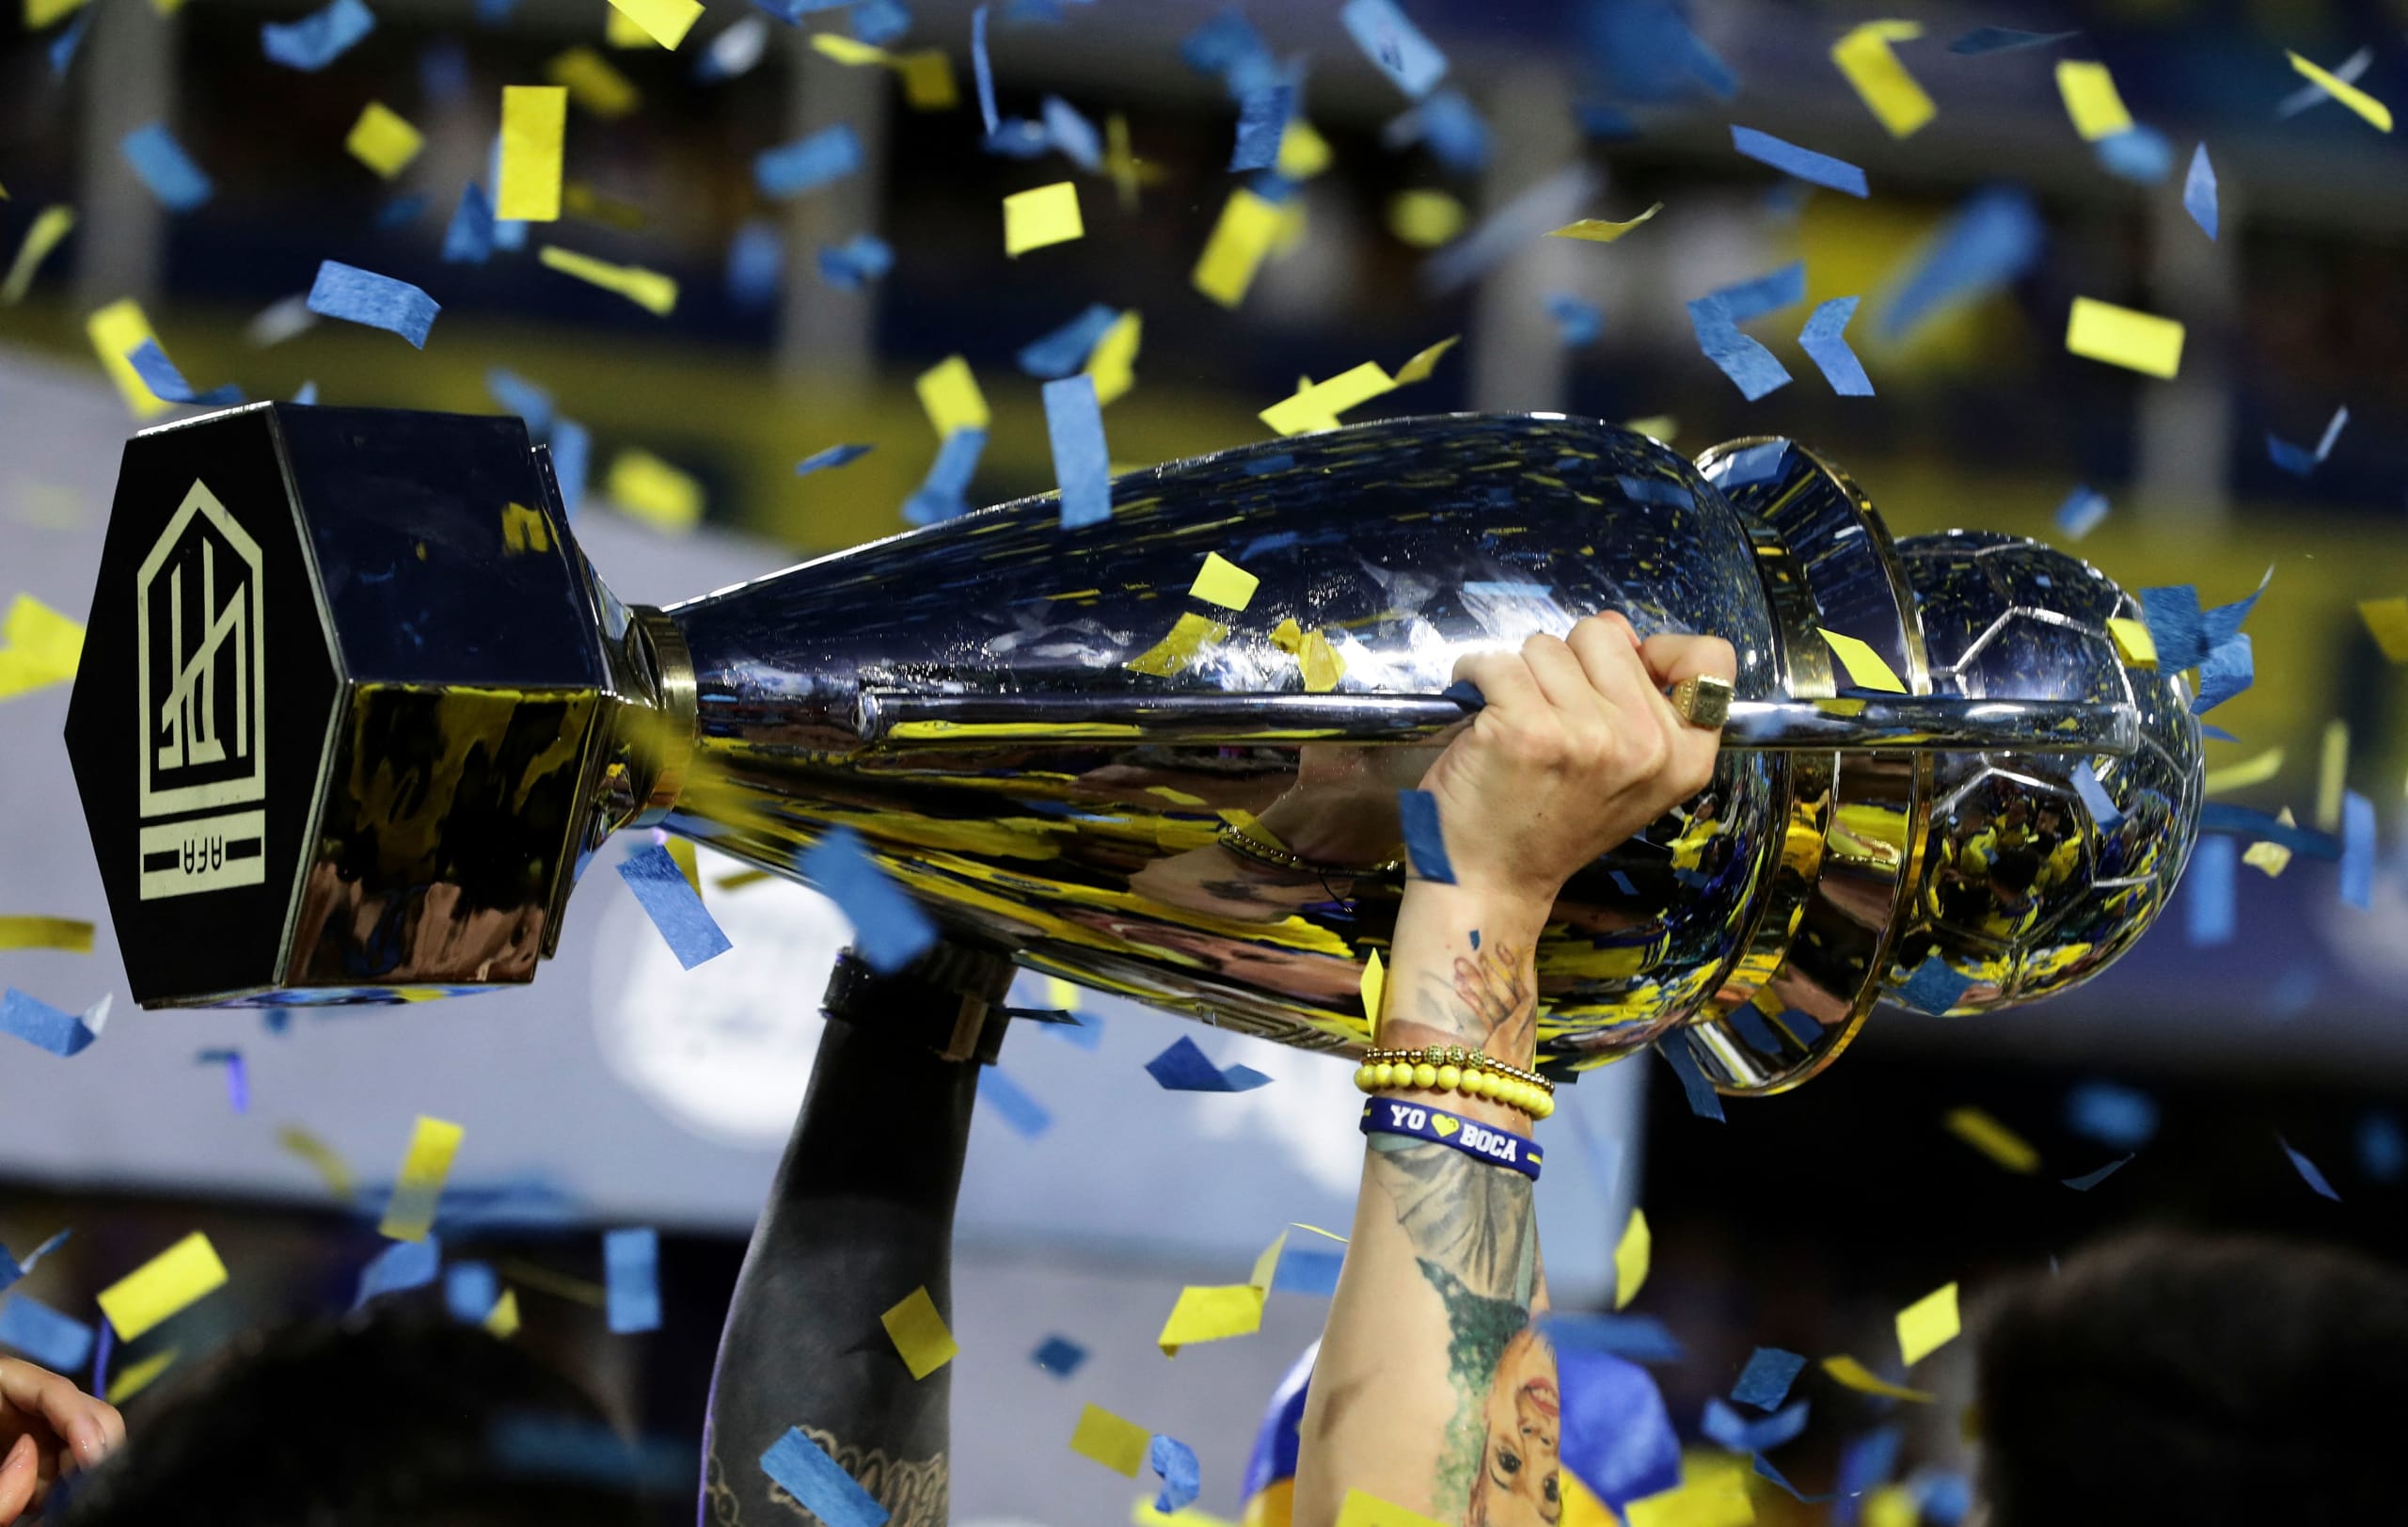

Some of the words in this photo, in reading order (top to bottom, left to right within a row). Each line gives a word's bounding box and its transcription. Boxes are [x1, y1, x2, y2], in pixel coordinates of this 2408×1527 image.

[183, 835, 222, 875] AFA
[1390, 1104, 1427, 1130] YO
[1459, 1123, 1518, 1163] BOCA
